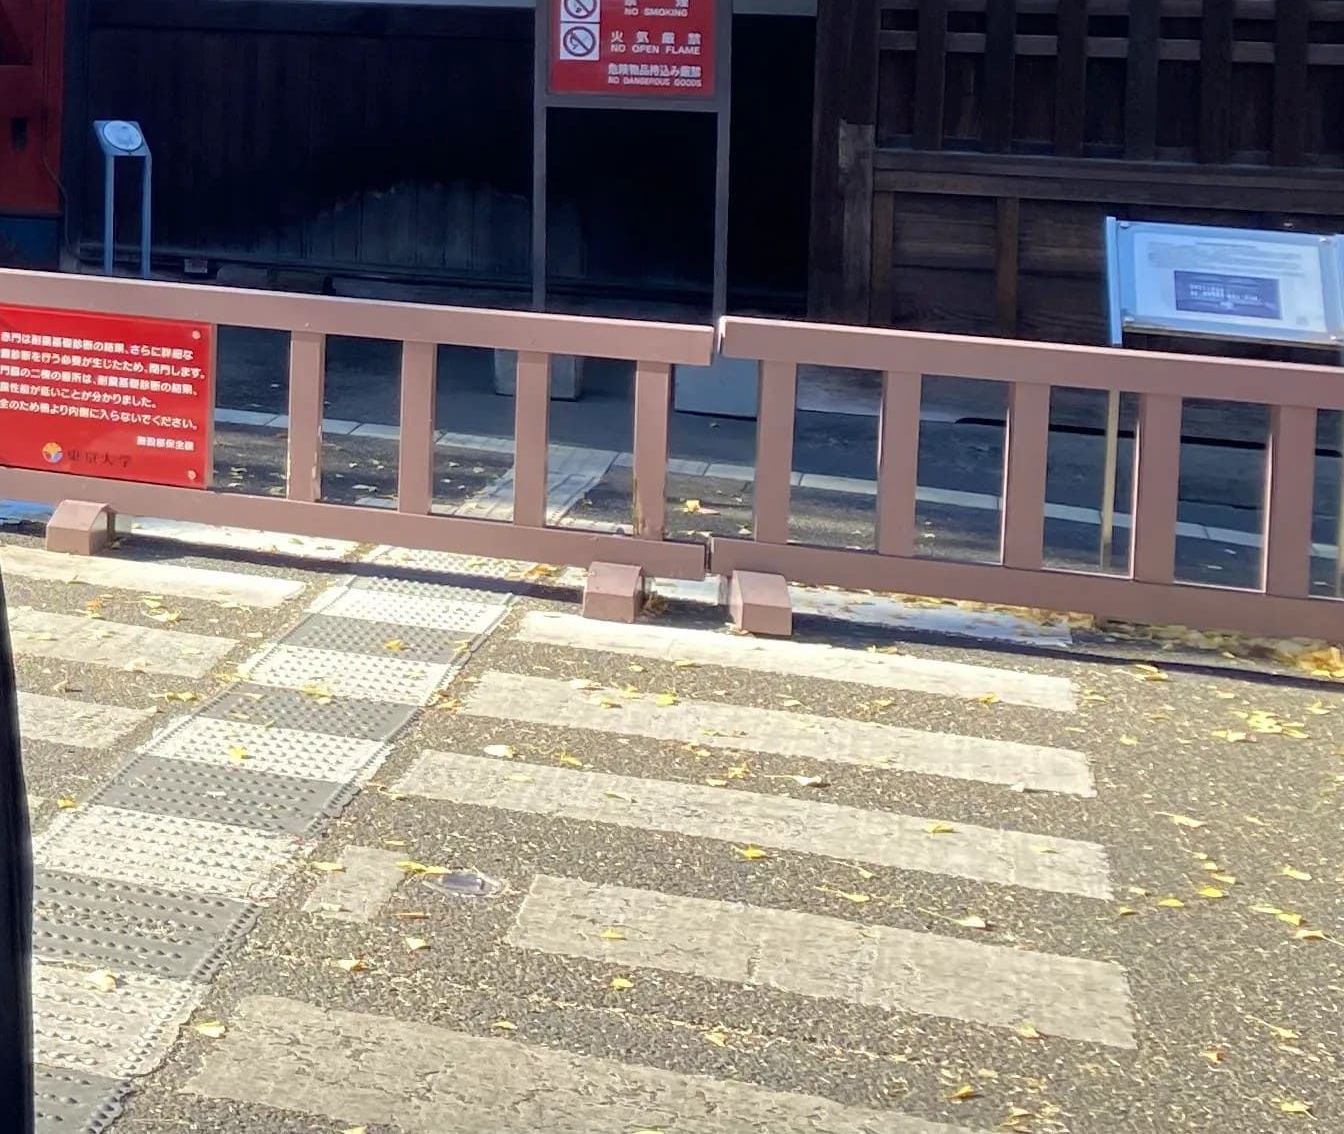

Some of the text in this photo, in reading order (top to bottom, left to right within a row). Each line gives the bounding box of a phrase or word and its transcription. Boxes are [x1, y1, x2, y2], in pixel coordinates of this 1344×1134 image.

[624, 8, 688, 17] NO SMOKING
[631, 45, 659, 54] OPEN
[665, 46, 701, 55] FLAME
